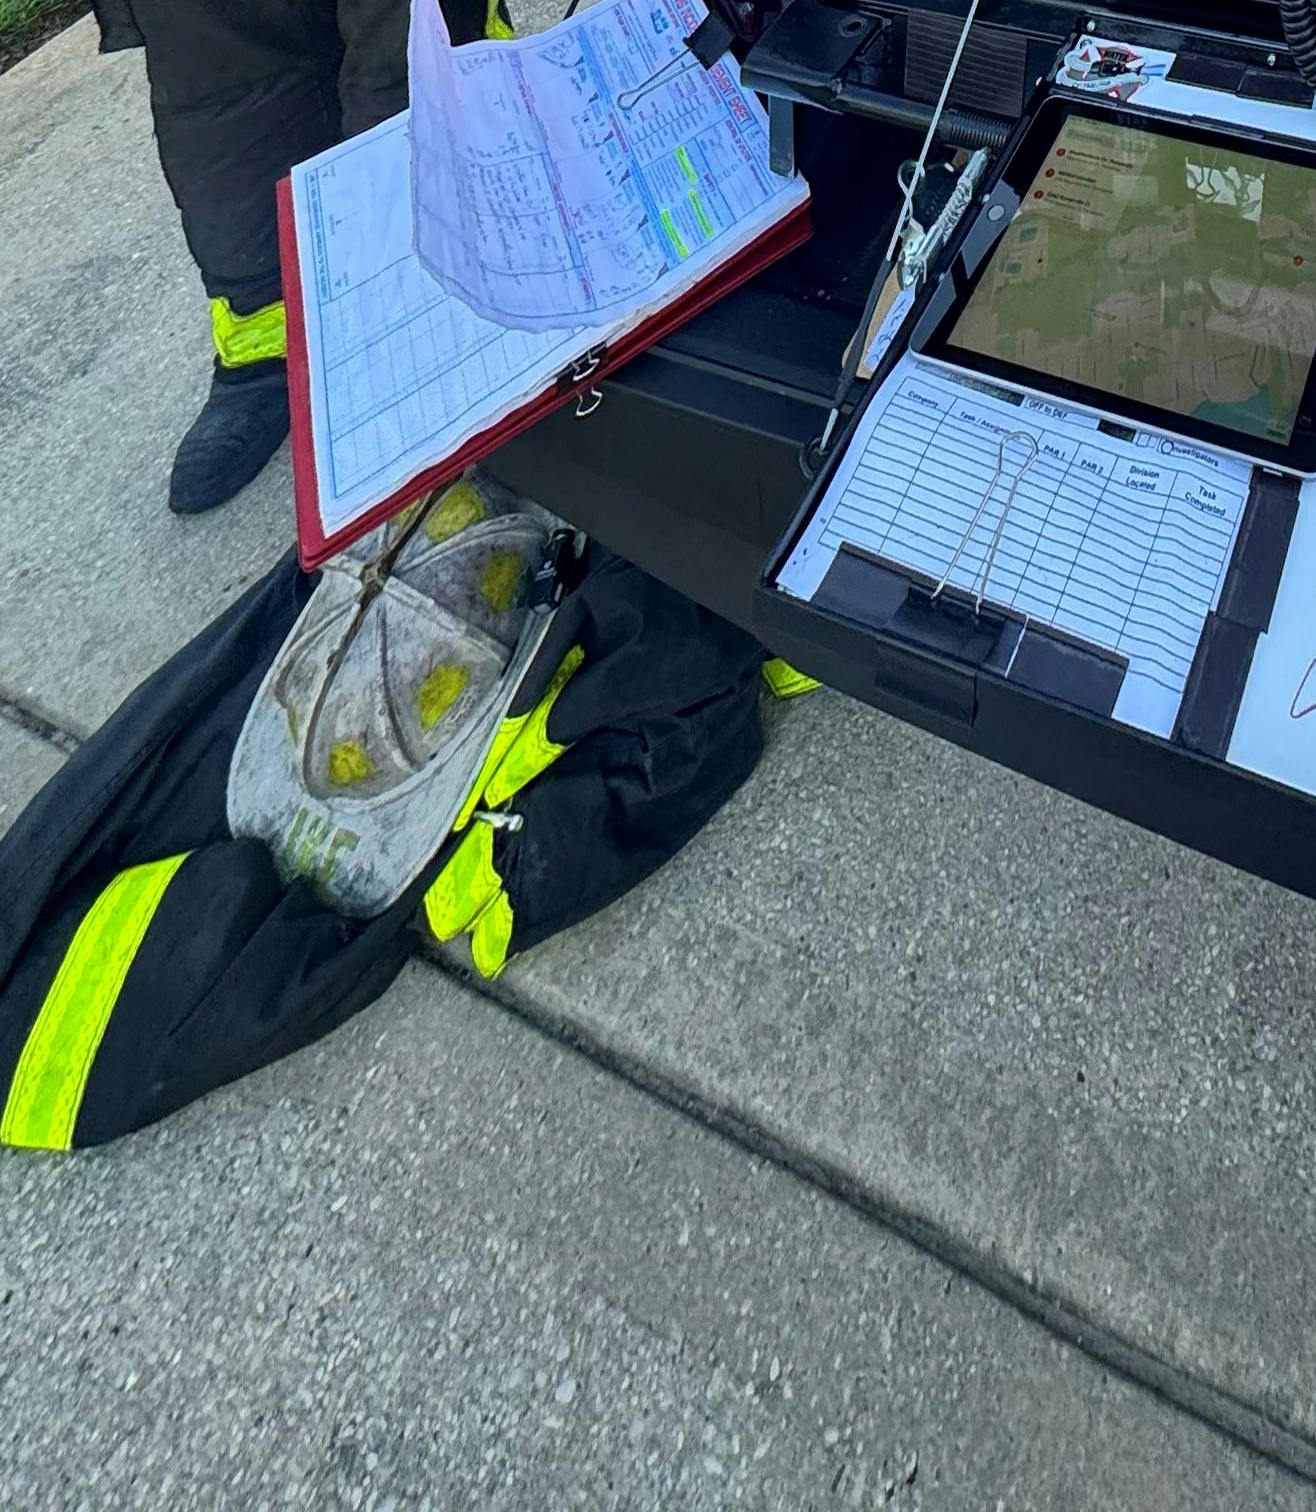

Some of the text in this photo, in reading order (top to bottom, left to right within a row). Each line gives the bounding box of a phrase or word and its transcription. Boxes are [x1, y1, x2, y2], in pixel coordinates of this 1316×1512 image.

[907, 389, 939, 409] Company
[1043, 443, 1060, 458] PAR
[1081, 458, 1097, 472] PAR
[1130, 465, 1160, 479] Division
[1199, 485, 1217, 501] Task
[1184, 491, 1227, 517] Completed
